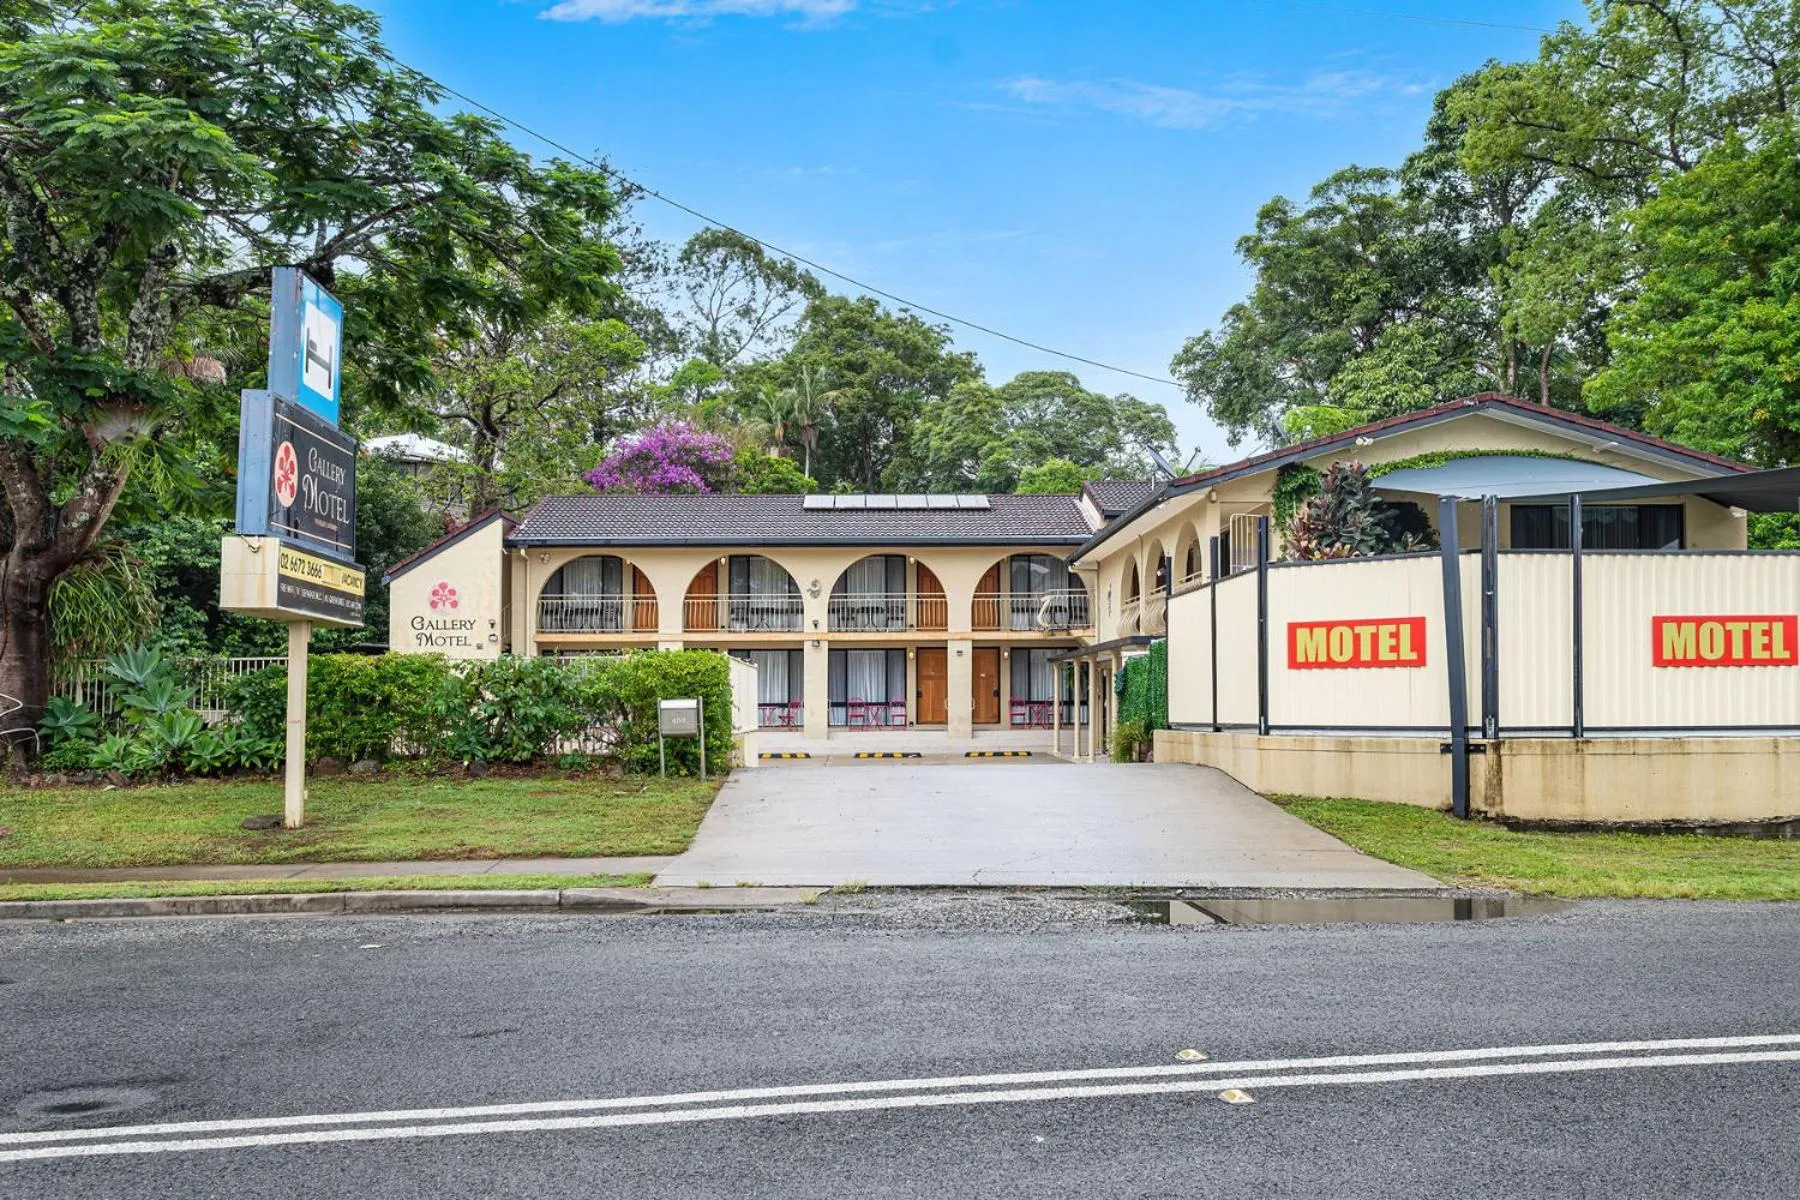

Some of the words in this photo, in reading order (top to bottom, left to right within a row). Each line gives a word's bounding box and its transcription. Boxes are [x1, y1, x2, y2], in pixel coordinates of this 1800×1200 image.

[308, 447, 346, 485] GALLERY
[302, 474, 350, 524] MOTEL
[280, 552, 289, 570] 02
[290, 556, 306, 574] 6672
[411, 616, 477, 631] GALLERY
[416, 632, 472, 646] MOTEL
[1662, 621, 1791, 660] MOTEL
[1296, 623, 1417, 663] MOTEL
